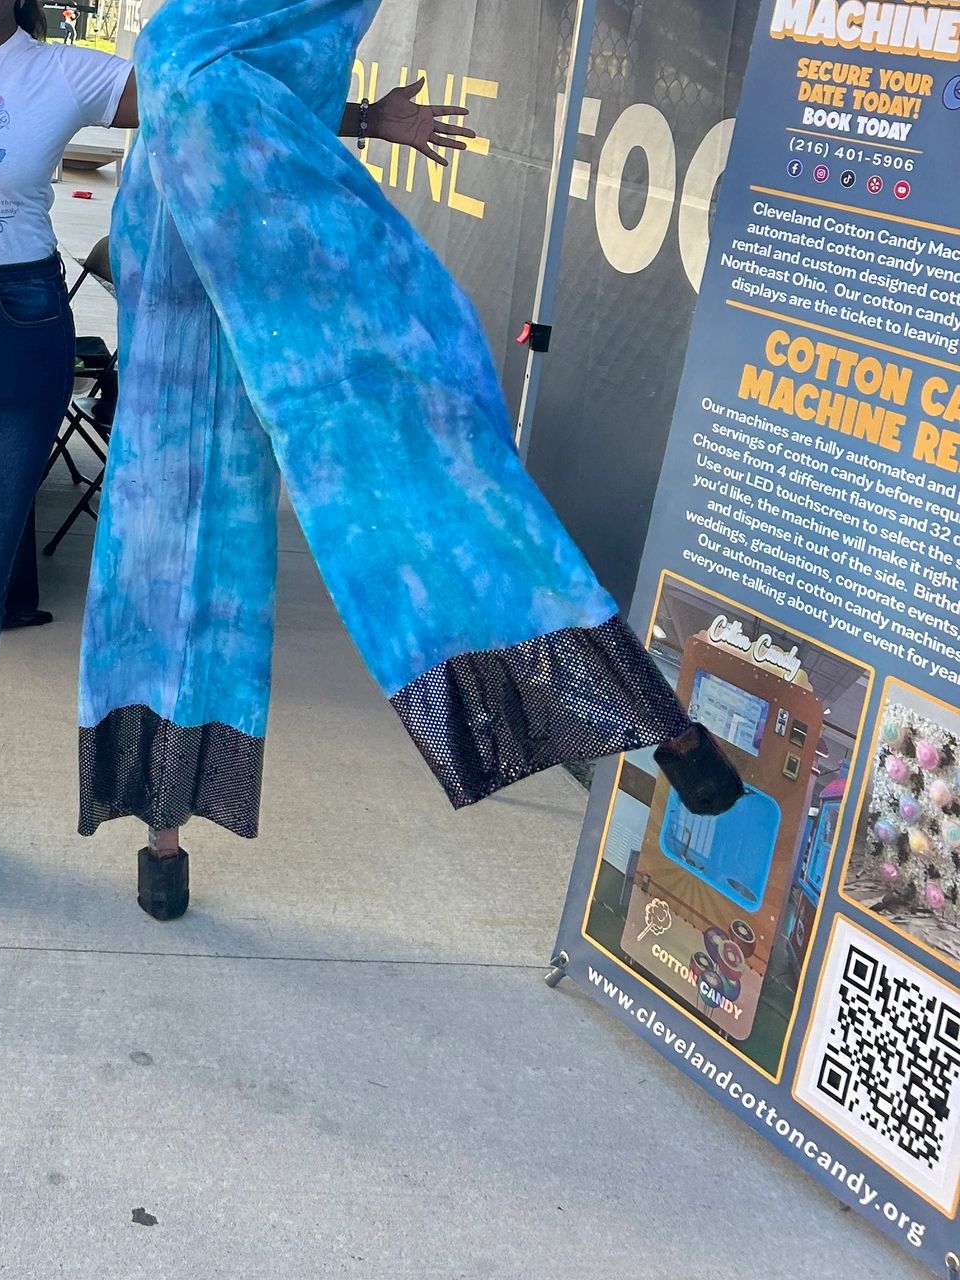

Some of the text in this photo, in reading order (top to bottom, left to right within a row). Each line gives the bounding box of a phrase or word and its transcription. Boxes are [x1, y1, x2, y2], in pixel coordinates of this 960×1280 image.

[797, 57, 873, 88] SECURE
[879, 68, 934, 96] YOUR
[798, 81, 845, 108] DATE
[852, 90, 921, 119] TODAY!
[789, 136, 914, 172] (216) 401-5906
[802, 107, 912, 142] BOOK TODAY
[747, 222, 825, 250] automated
[827, 242, 875, 262] cotton
[878, 253, 923, 276] candy
[752, 201, 821, 229] Cleveland
[823, 218, 875, 241] Cotton
[877, 230, 926, 255] Candy
[721, 253, 960, 331] Northeast Ohio. Our cotton candy
[732, 238, 771, 258] rental
[773, 248, 799, 265] and
[802, 256, 857, 279] custom
[859, 269, 928, 297] designed
[732, 277, 959, 354] displays are the ticket to leaving
[765, 329, 913, 406] COTTON
[738, 363, 907, 453] MACHINE
[701, 397, 956, 499] Our machines are fully automated and
[712, 422, 765, 450] servings
[767, 442, 783, 456] of
[783, 448, 829, 473] cotton
[831, 466, 874, 491] candy
[875, 479, 923, 508] before
[693, 433, 741, 461] Choose
[742, 451, 774, 474] from
[776, 465, 787, 478] 4
[788, 469, 848, 502] different
[849, 491, 897, 520] flavors
[899, 513, 928, 533] and
[929, 522, 951, 542] 32
[696, 453, 722, 473] Use
[723, 466, 744, 482] our
[746, 472, 774, 493] LED
[776, 484, 860, 528] touchscreen
[862, 518, 878, 535] to
[880, 528, 925, 555] select
[928, 544, 953, 565] the
[686, 510, 748, 547] weddings,
[750, 538, 832, 584] graduations,
[835, 575, 906, 613] corporate
[693, 474, 959, 591] you'd like, the machine will make it right
[707, 500, 732, 517] and
[733, 509, 791, 541] dispense
[793, 532, 804, 548] it
[805, 540, 829, 559] out
[831, 551, 848, 565] of
[849, 556, 872, 576] the
[874, 569, 908, 593] side.
[683, 549, 740, 582] everyone
[742, 573, 787, 606] talking
[787, 595, 829, 623] about
[828, 615, 862, 638] your
[863, 631, 906, 659] event
[906, 647, 929, 669] for
[697, 533, 721, 553] Our
[722, 546, 796, 586] automated
[796, 578, 843, 608] cotton
[844, 601, 890, 629] candy
[708, 614, 802, 682] Cotton Candy
[651, 943, 744, 1020] COTTON CANDY
[588, 965, 926, 1248] www.clevelandcottoncandy.org
